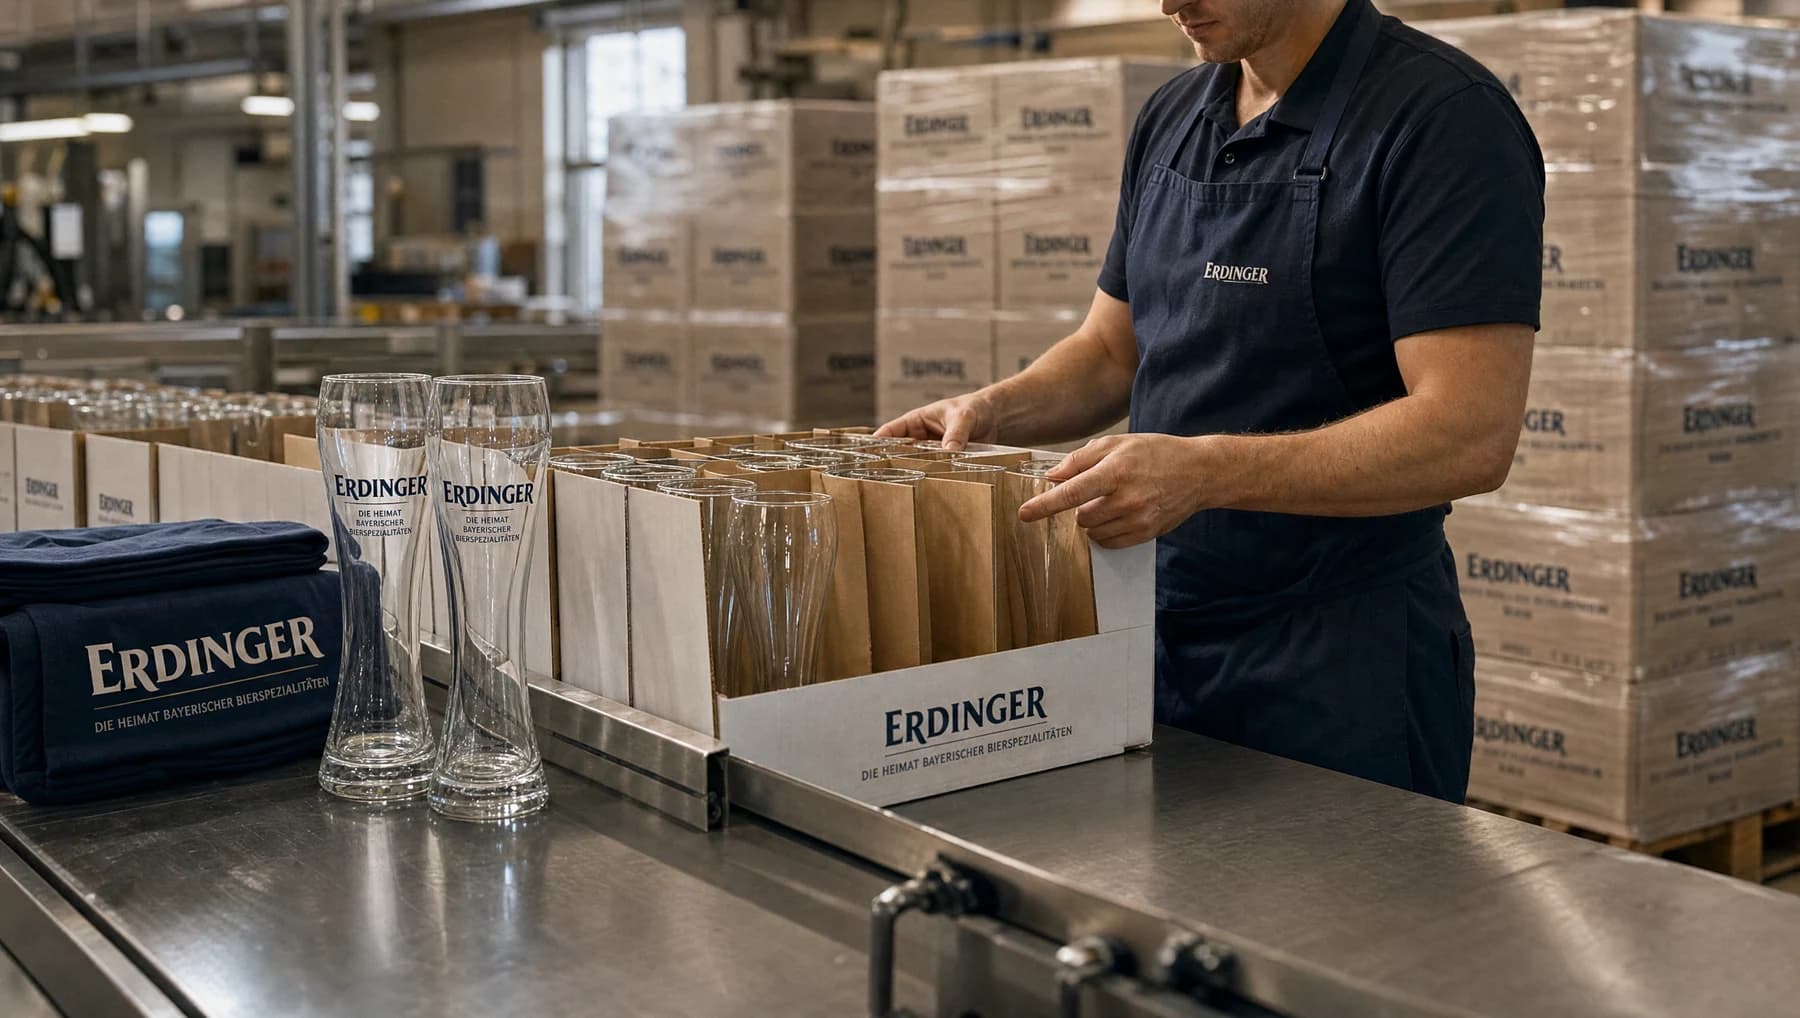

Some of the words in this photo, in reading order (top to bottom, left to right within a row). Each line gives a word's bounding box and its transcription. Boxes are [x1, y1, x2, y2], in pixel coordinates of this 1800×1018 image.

[1203, 261, 1268, 284] ERDINGER
[335, 474, 427, 500] ERDINGER
[443, 480, 534, 507] ERDINGER
[356, 519, 404, 527] BAYERISCHER
[358, 509, 371, 518] DIE
[373, 509, 402, 517] HEIMAT
[466, 516, 478, 524] DIE
[481, 516, 508, 524] HEIMAT
[349, 527, 412, 537] BIERSPEZIALITÄTEN
[455, 533, 520, 544] BIERSPEZIALITÄTEN
[463, 525, 511, 534] BAYERISCHER
[1467, 554, 1570, 591] ERDINGER
[84, 616, 325, 696] ERDINGER
[95, 719, 114, 733] DIE
[118, 711, 161, 729] HEIMAT
[163, 697, 234, 721] BAYERISCHER
[236, 676, 329, 707] BIERSPEZIALITÄTEN
[885, 686, 1047, 747] ERDINGER
[1475, 716, 1567, 756] RDINGER
[861, 769, 879, 781] DIE
[882, 759, 919, 777] HEIMAT
[923, 746, 984, 768] BAYERISCHER
[987, 725, 1073, 753] BIERSPEZIALITÄTEN
